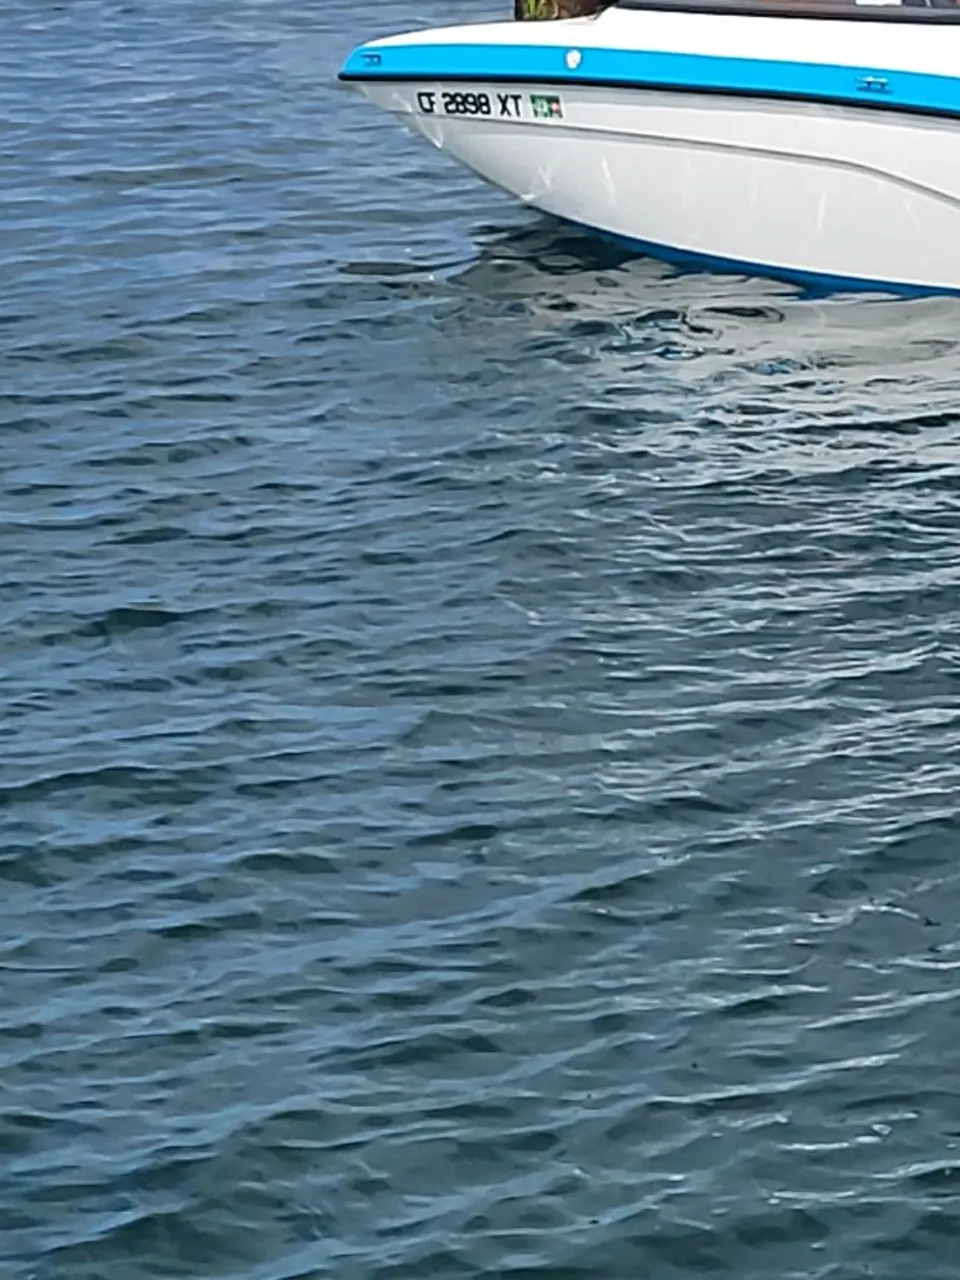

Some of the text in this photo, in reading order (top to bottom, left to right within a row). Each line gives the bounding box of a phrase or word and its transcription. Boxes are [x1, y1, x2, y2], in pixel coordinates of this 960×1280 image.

[417, 92, 436, 114] CF
[441, 92, 491, 115] 2898
[496, 93, 522, 117] XT
